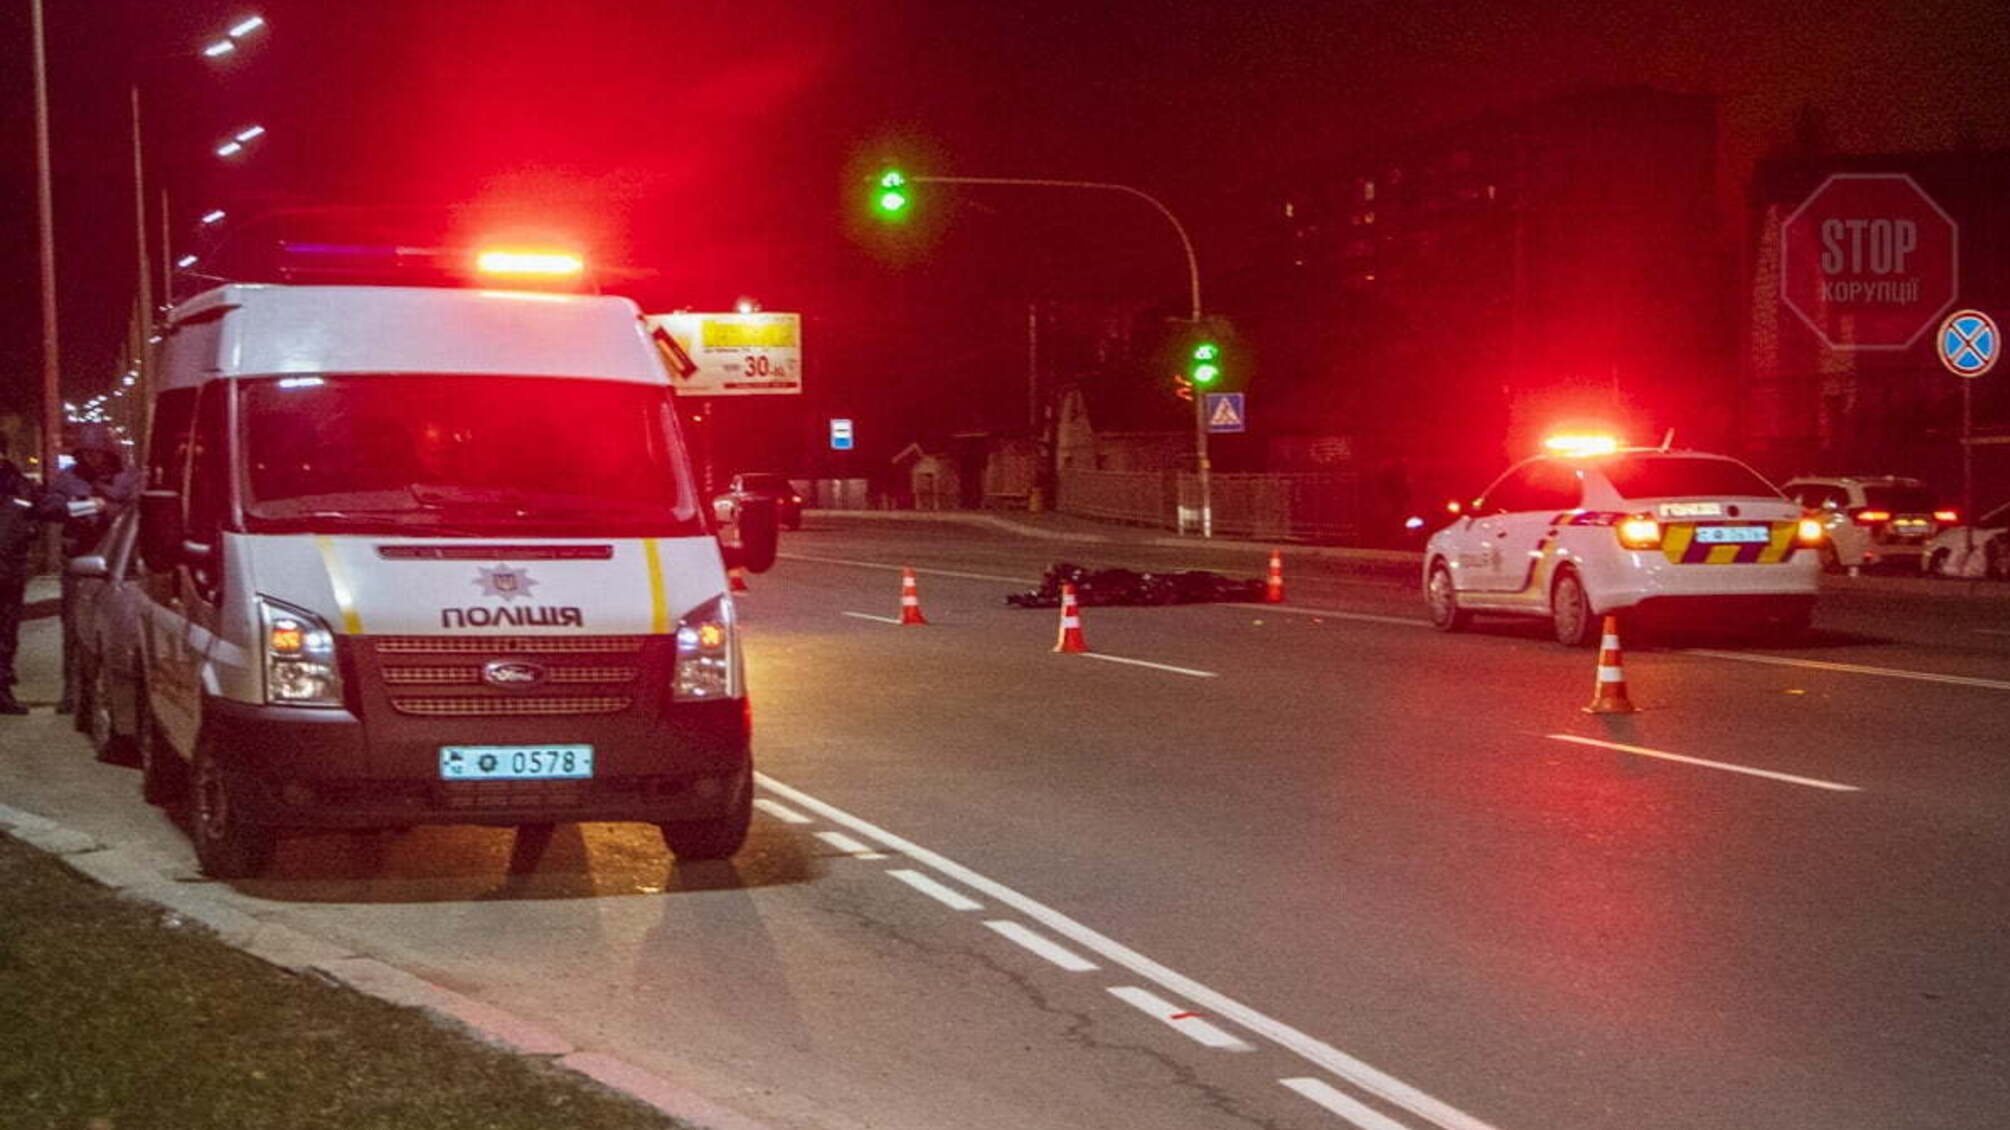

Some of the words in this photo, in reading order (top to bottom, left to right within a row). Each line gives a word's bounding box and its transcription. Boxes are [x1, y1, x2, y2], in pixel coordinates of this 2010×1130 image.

[744, 355, 768, 377] 30
[441, 606, 583, 628] ПОЛІЦІЯ
[512, 751, 575, 773] 0578
